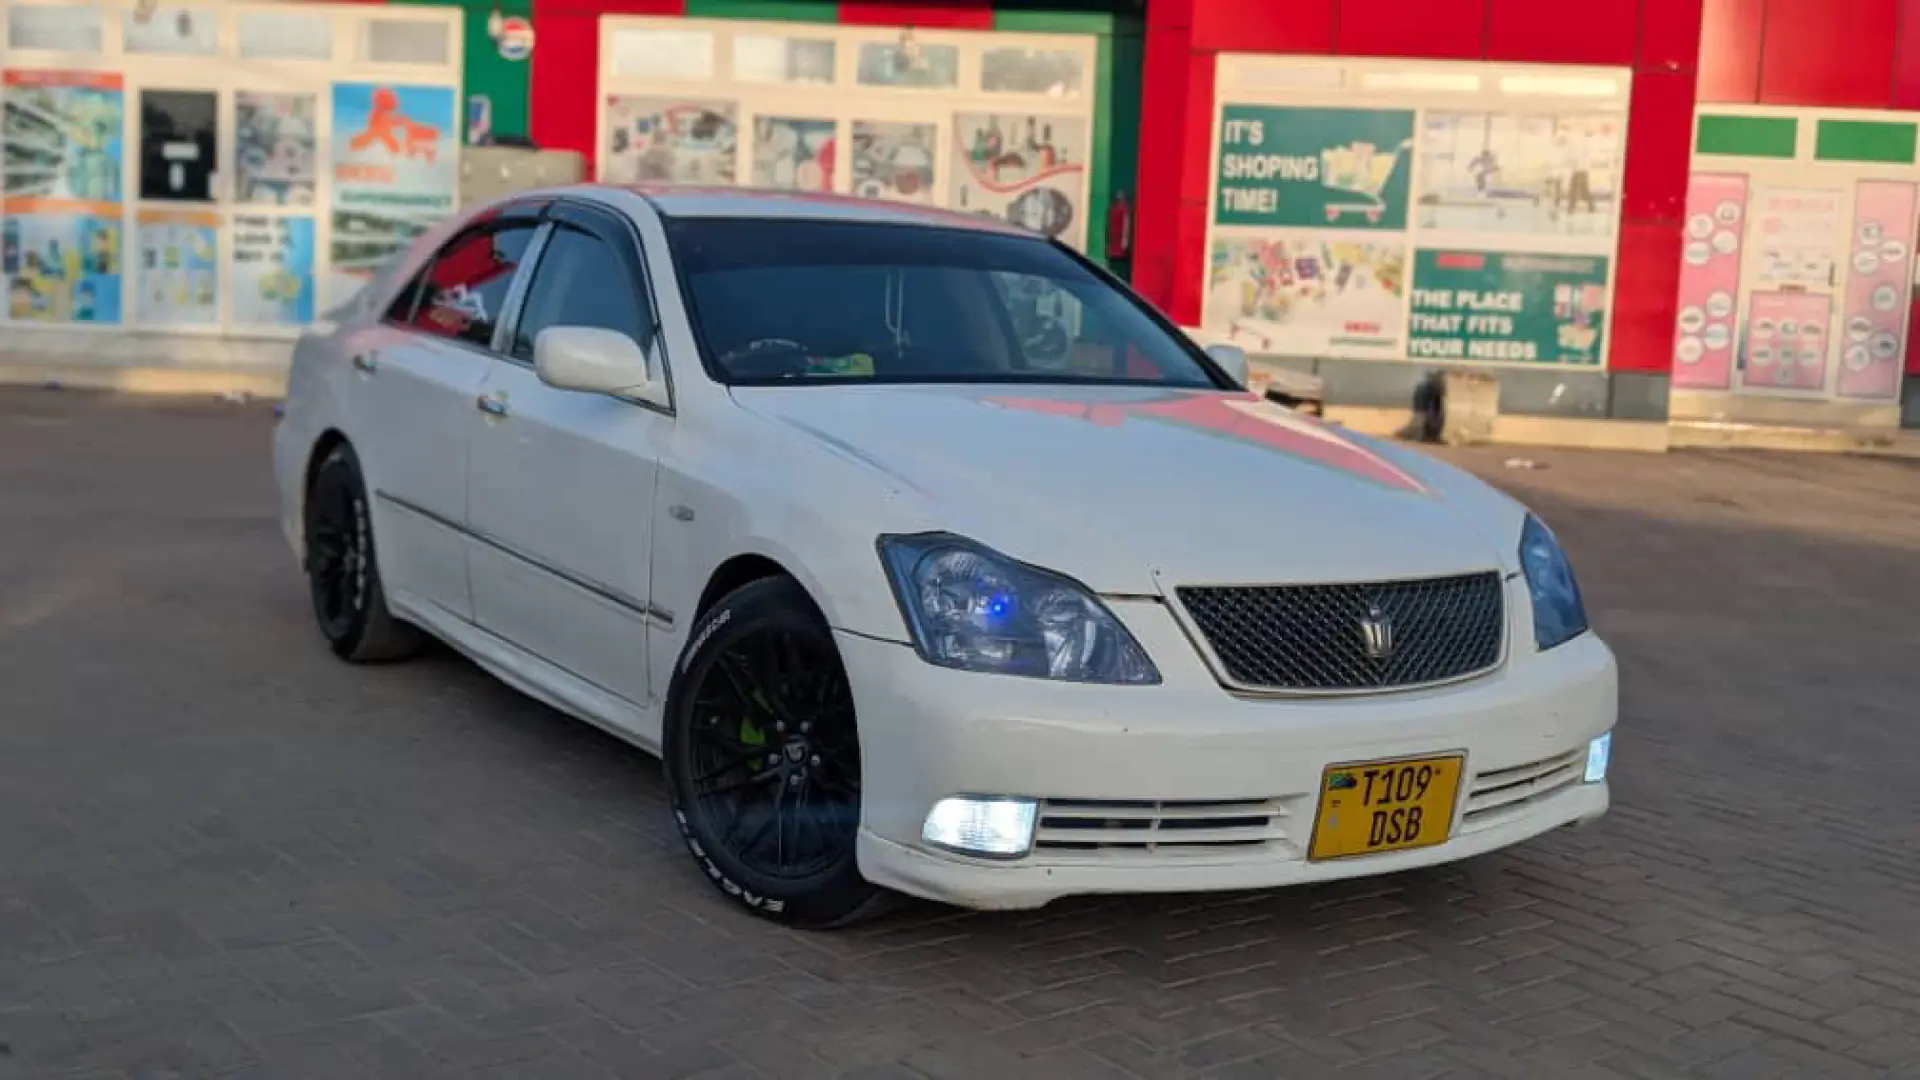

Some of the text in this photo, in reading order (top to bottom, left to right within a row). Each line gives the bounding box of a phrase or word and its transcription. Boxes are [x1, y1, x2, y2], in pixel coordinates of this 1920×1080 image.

[1224, 120, 1264, 146] IT'S
[1223, 153, 1319, 181] SHOPING
[1221, 186, 1278, 214] TIME!
[1412, 288, 1524, 313] THE PLACE
[1412, 313, 1513, 336] THAT FITS
[1410, 337, 1464, 357] YOUR
[1467, 340, 1538, 360] NEEDS
[1363, 765, 1433, 807] T109
[1367, 806, 1423, 847] DSB
